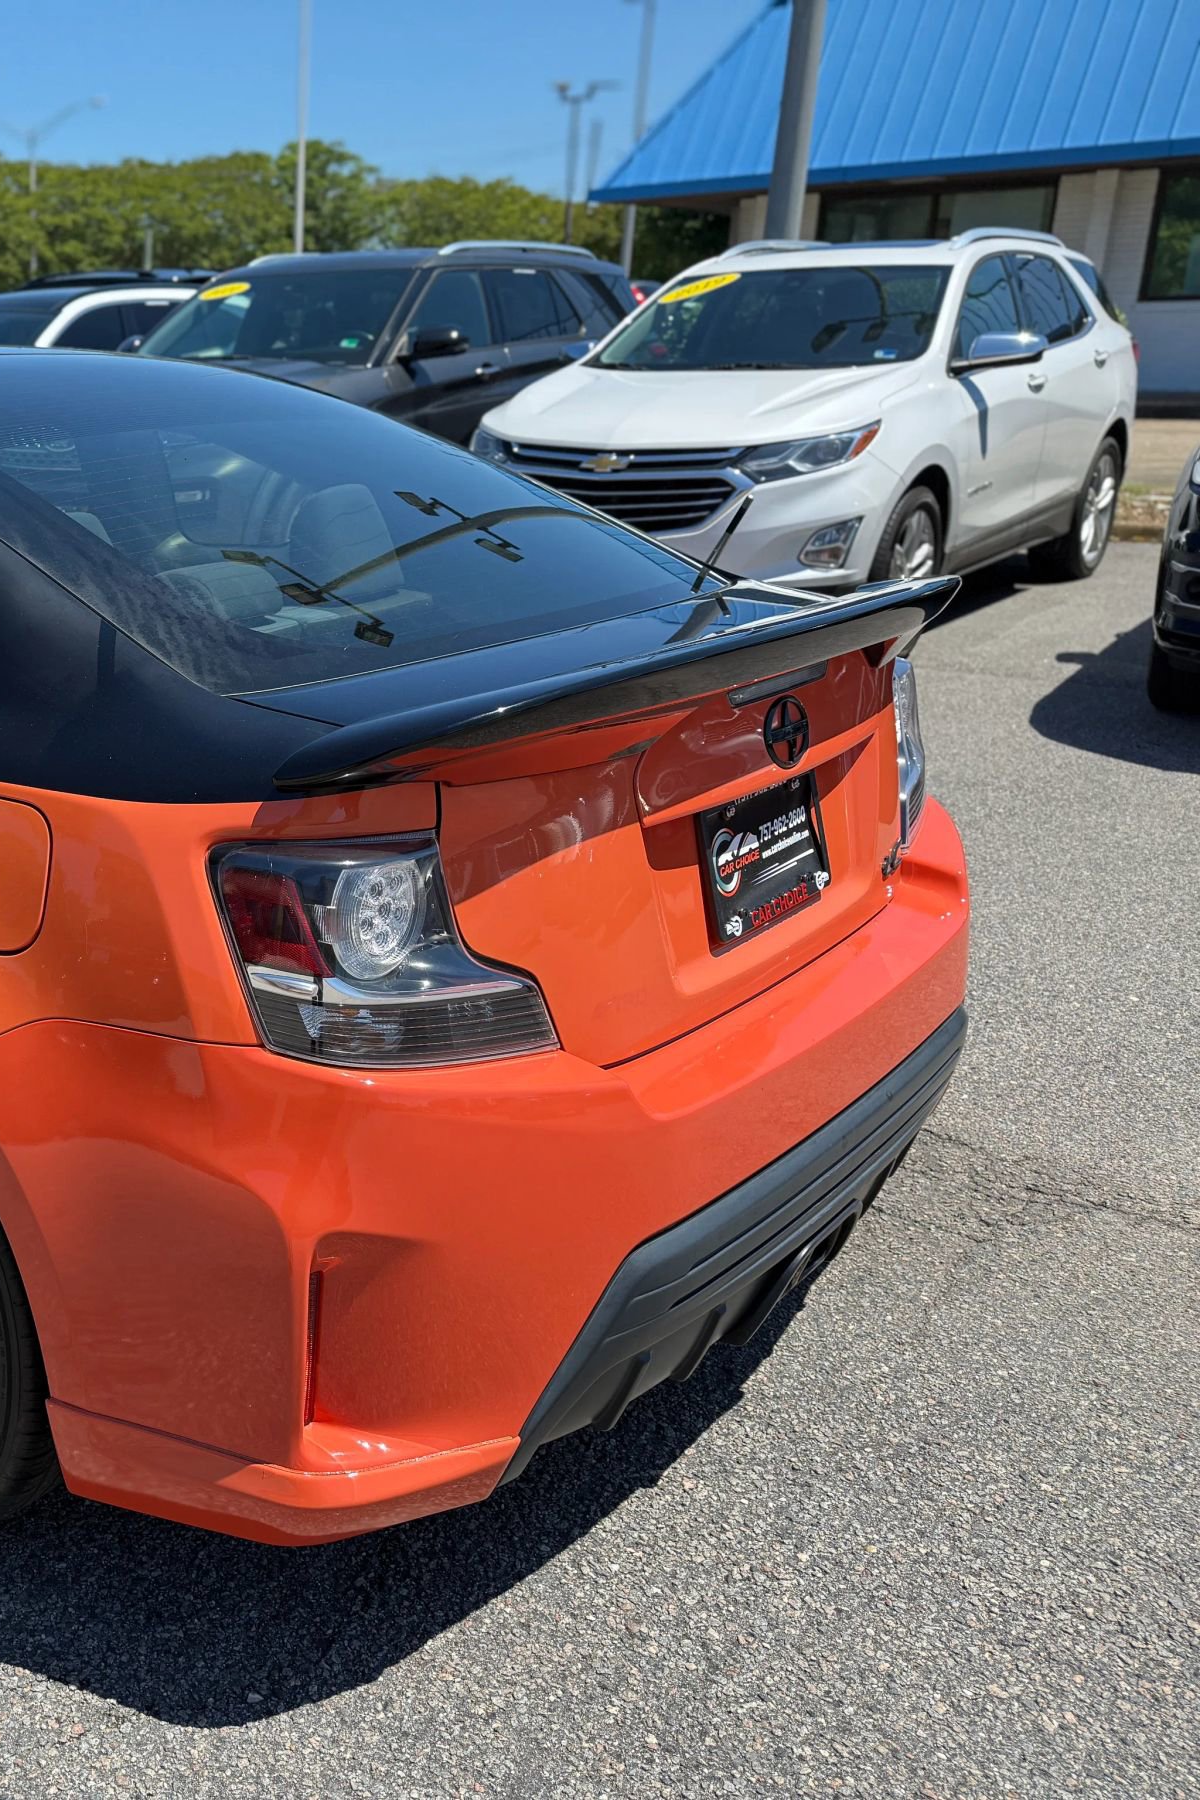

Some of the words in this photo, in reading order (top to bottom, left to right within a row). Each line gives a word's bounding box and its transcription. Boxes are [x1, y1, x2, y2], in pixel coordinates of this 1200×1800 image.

[759, 805, 806, 843] 757-962-2600
[720, 863, 735, 877] CAR
[735, 849, 760, 869] CHOICE
[751, 903, 773, 926] CAR
[773, 882, 808, 914] CHOICE
